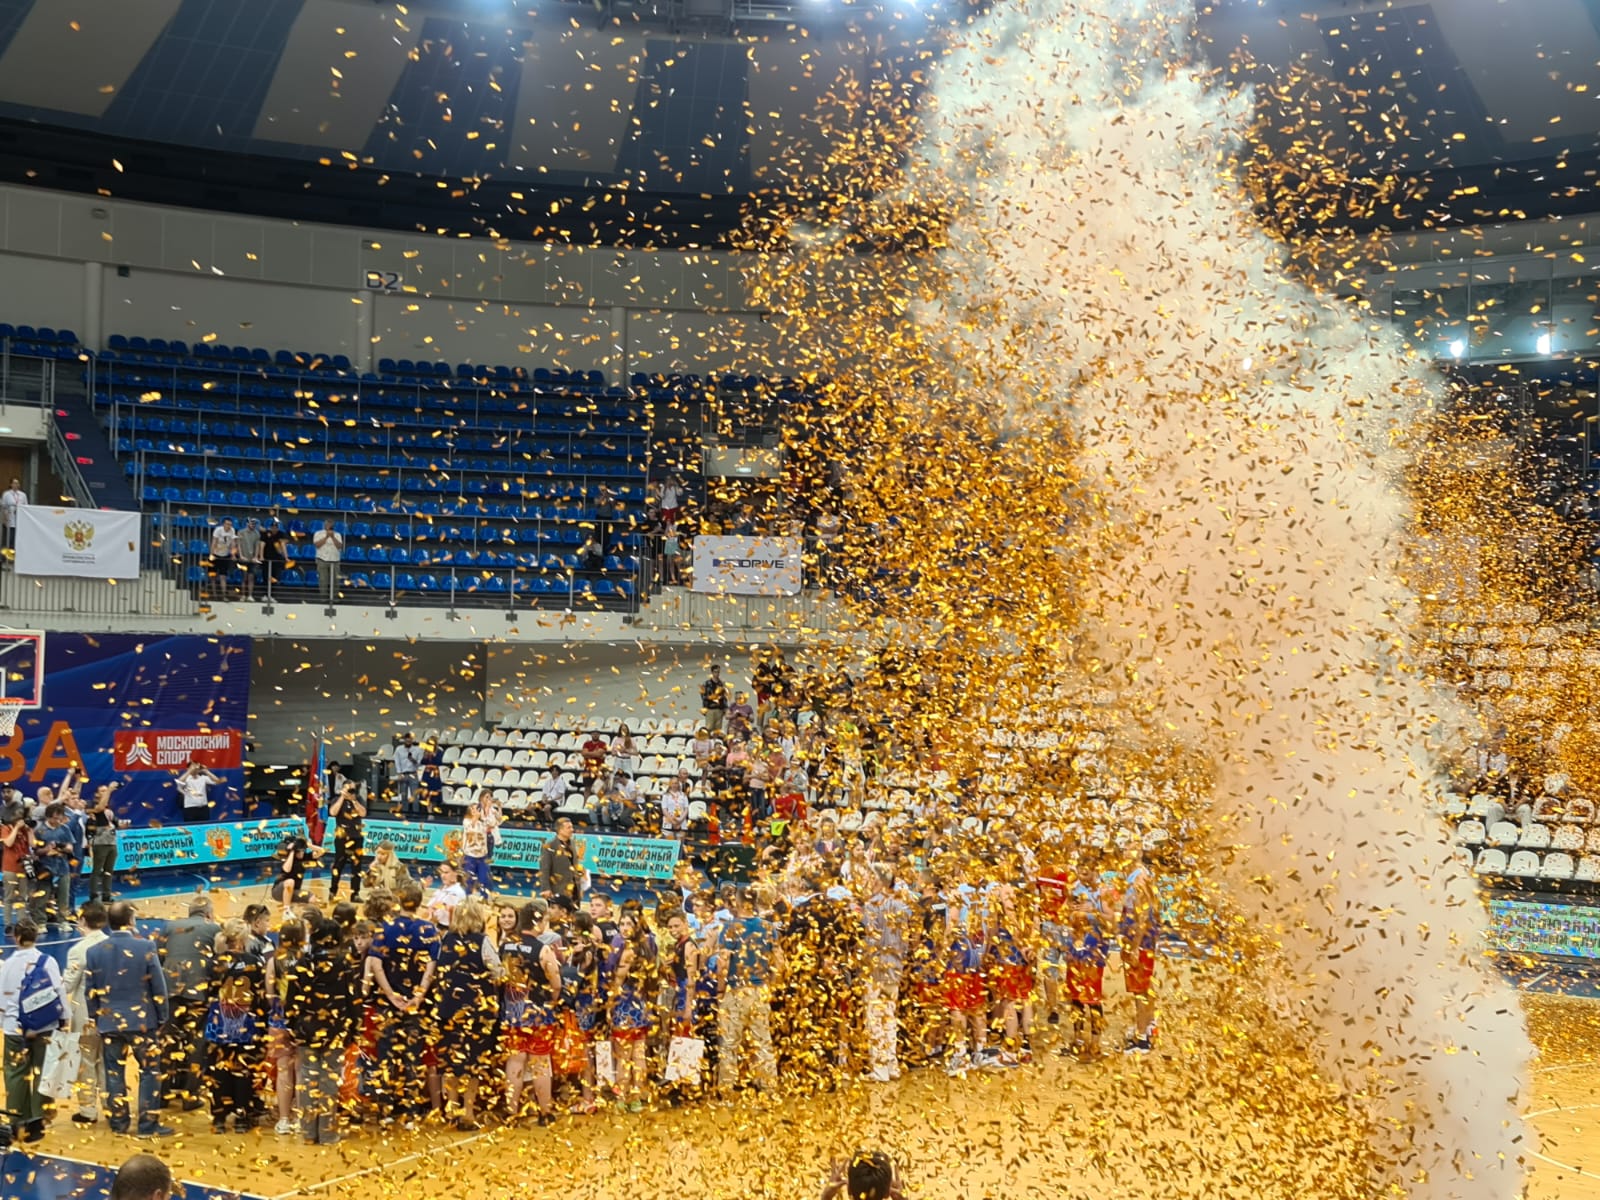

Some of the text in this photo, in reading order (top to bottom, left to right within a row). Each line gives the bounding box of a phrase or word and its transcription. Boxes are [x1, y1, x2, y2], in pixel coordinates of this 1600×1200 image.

[157, 733, 230, 750] МОСКОВСКИЙ
[156, 750, 192, 765] СПОРТ
[123, 836, 194, 852] ПРОФСОЮЗНЫЙ
[598, 847, 673, 862] ПРОФСОЮЗНЫЙ
